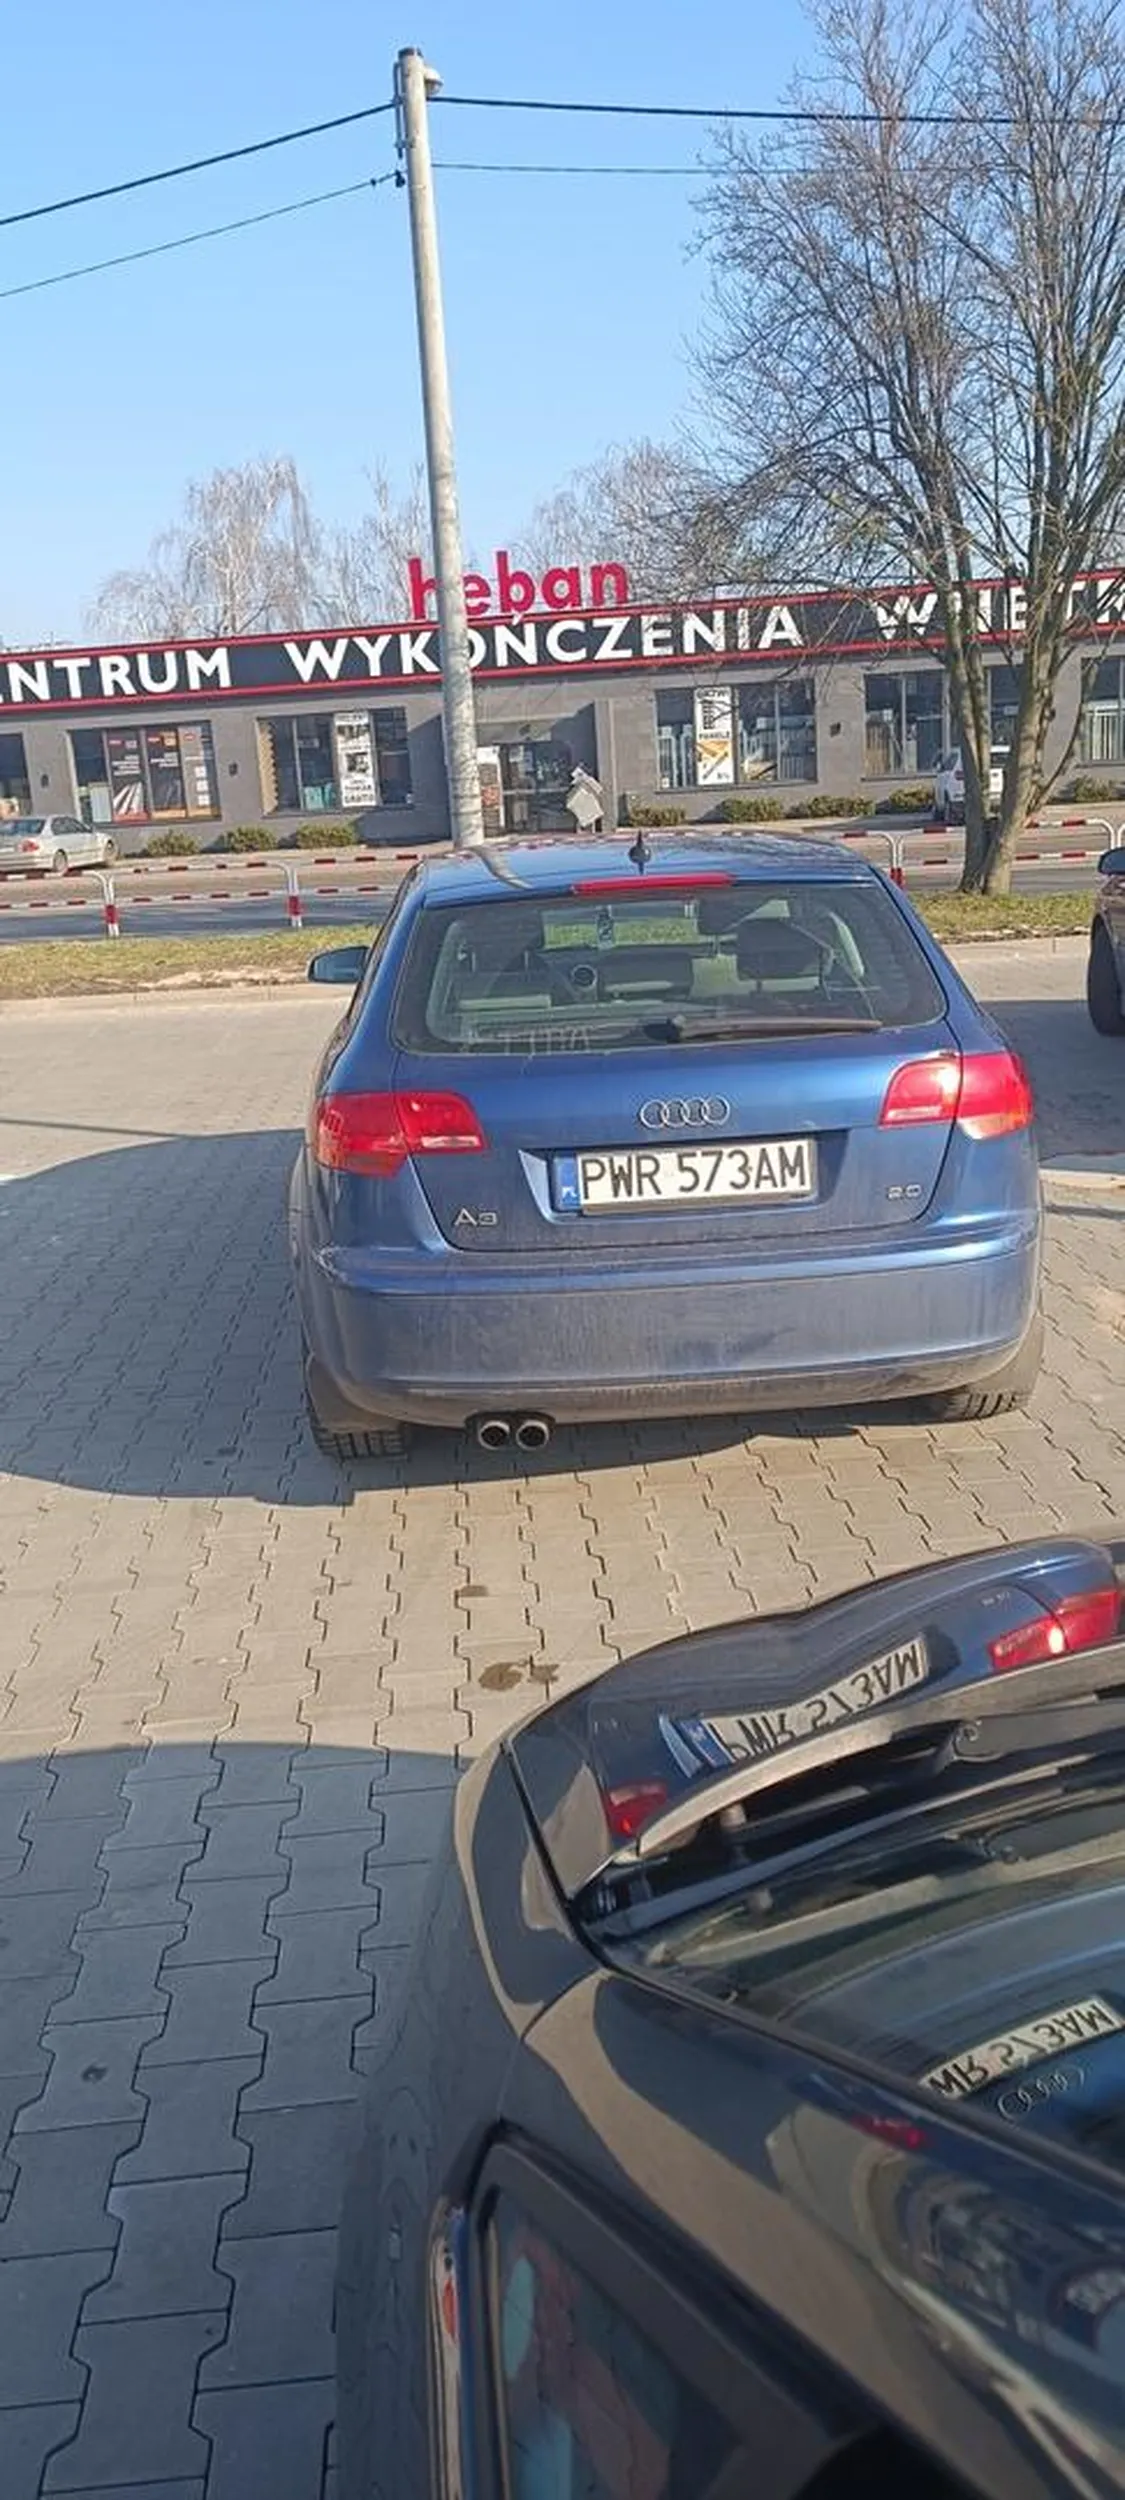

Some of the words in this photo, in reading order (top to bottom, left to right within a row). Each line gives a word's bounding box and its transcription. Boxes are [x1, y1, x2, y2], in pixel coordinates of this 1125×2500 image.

[408, 551, 629, 620] heban
[0, 647, 231, 703] NTRUM
[581, 1154, 661, 1200] PWR
[678, 1145, 806, 1193] 573AM
[454, 1207, 497, 1226] A3
